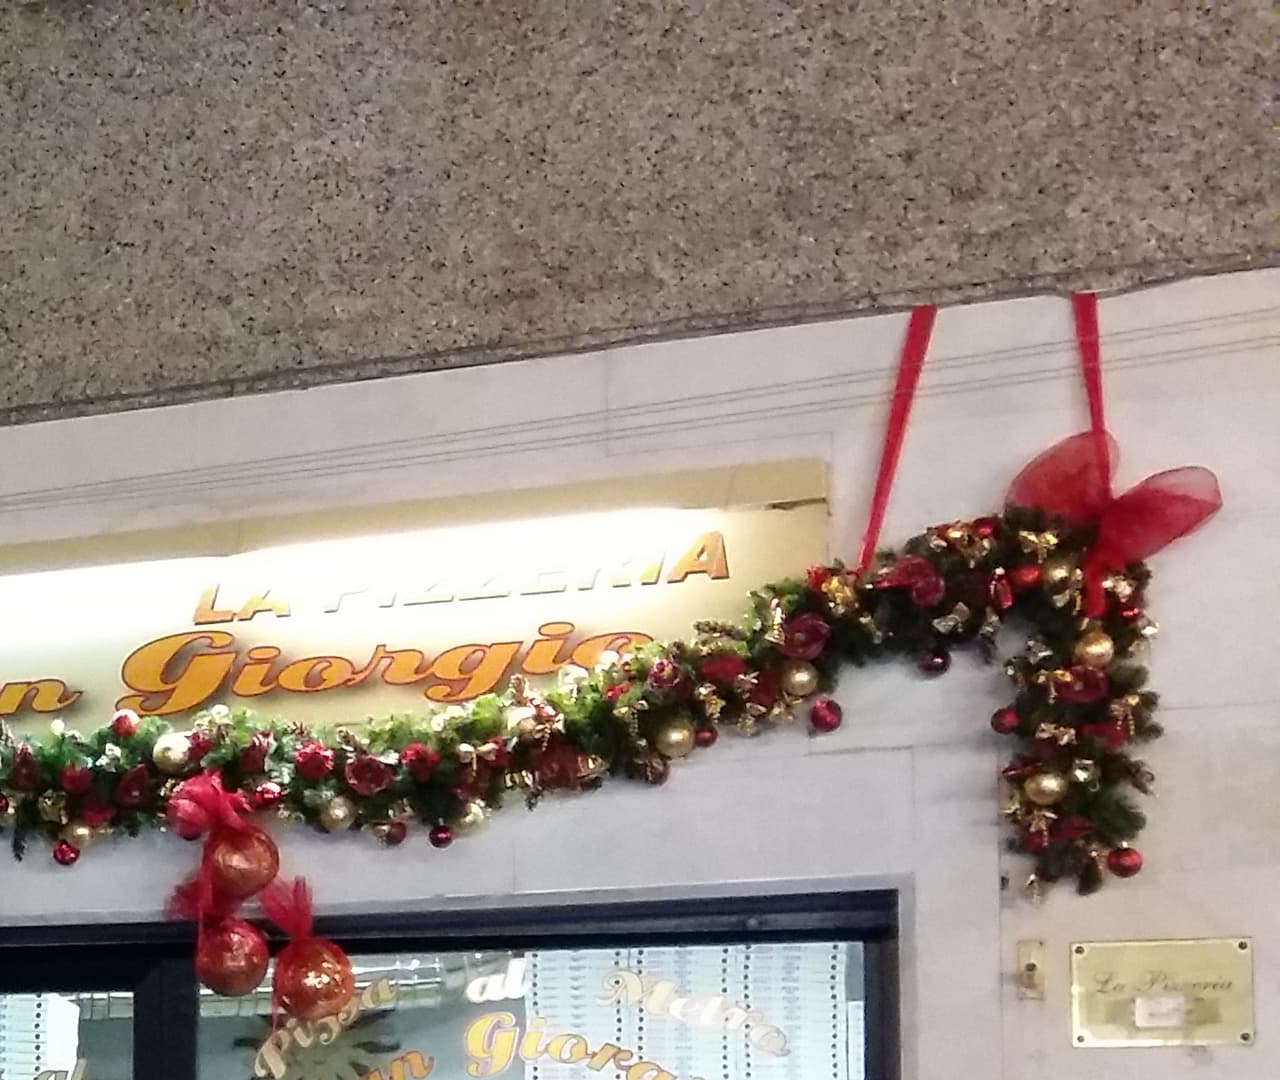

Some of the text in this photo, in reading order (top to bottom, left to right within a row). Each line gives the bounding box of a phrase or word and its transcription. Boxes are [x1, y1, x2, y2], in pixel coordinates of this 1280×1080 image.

[193, 583, 291, 625] LA
[115, 621, 654, 717] Giorgio
[467, 958, 529, 1003] al
[596, 968, 792, 1056] Metro
